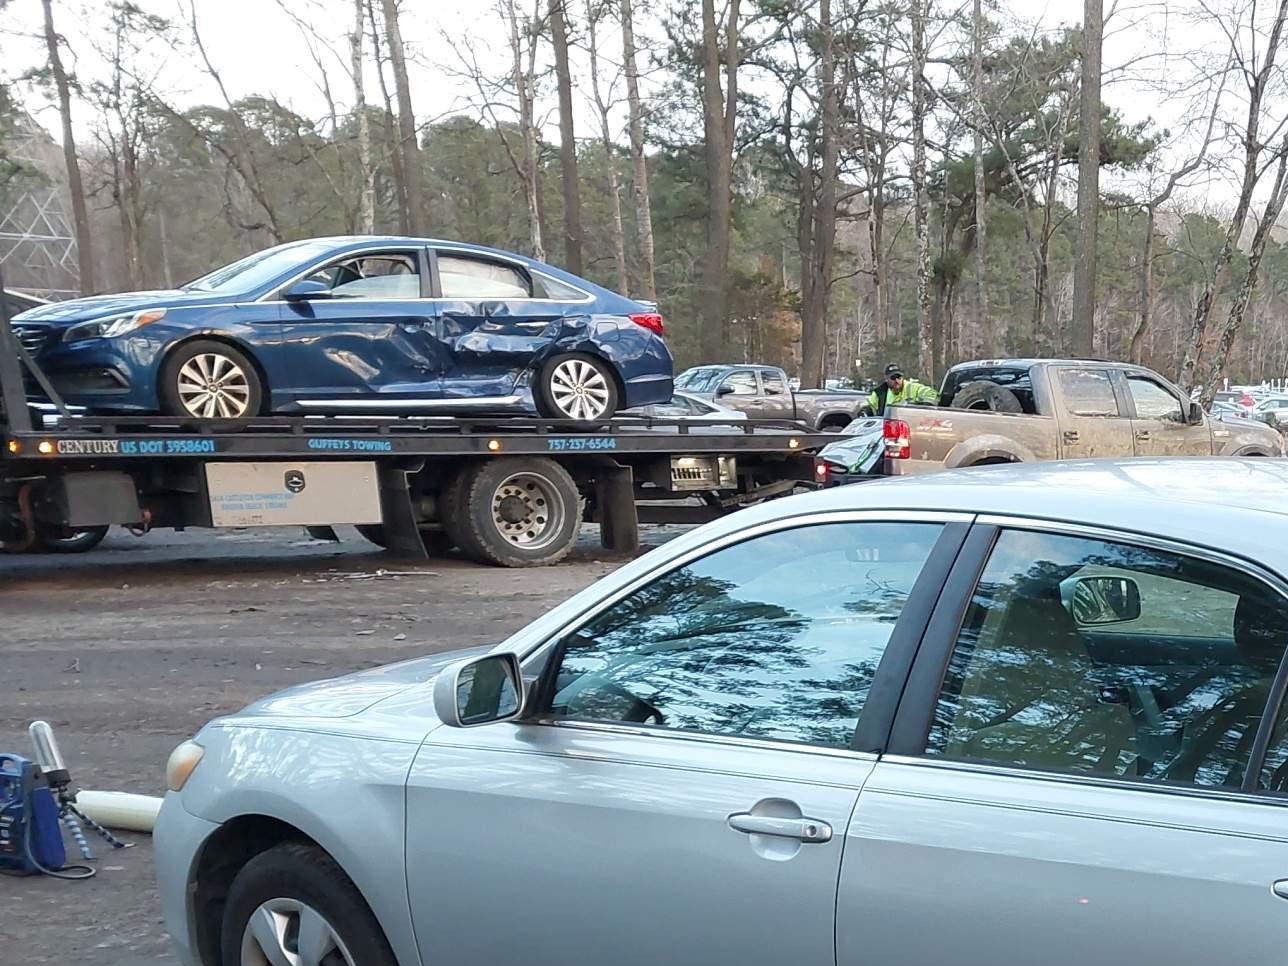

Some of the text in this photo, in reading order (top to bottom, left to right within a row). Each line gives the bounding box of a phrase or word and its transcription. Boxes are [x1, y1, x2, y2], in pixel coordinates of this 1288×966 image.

[57, 439, 119, 454] CENTURY
[121, 440, 215, 454] US DOT 3958601
[352, 440, 391, 451] TOWING
